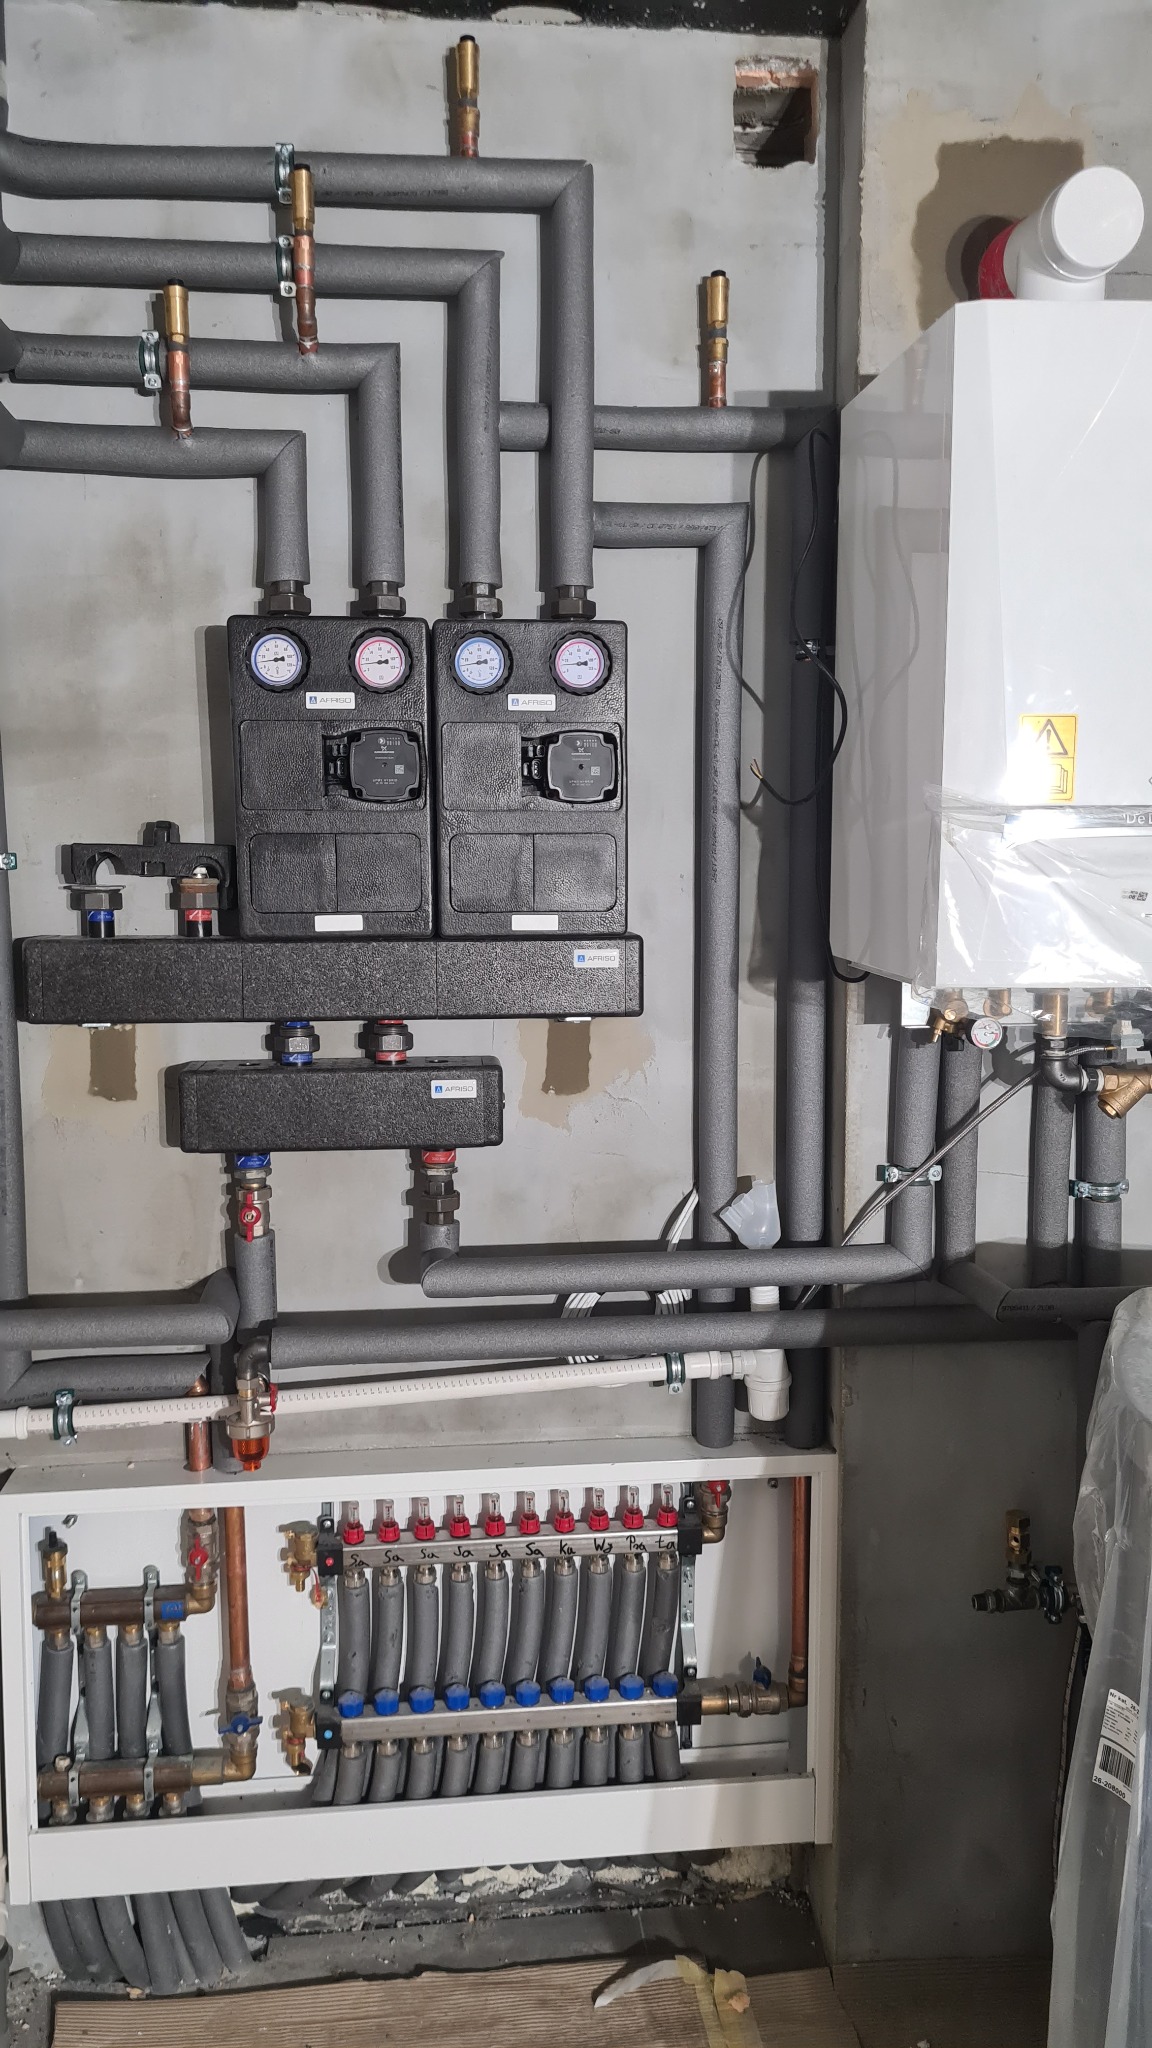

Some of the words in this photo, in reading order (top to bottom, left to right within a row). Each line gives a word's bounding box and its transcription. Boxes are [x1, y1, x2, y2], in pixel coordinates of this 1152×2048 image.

[383, 1550, 404, 1564] Sa
[420, 1548, 440, 1560] Sa
[454, 1546, 474, 1558] Sa
[488, 1544, 511, 1558] Sa
[526, 1542, 544, 1556] Sa
